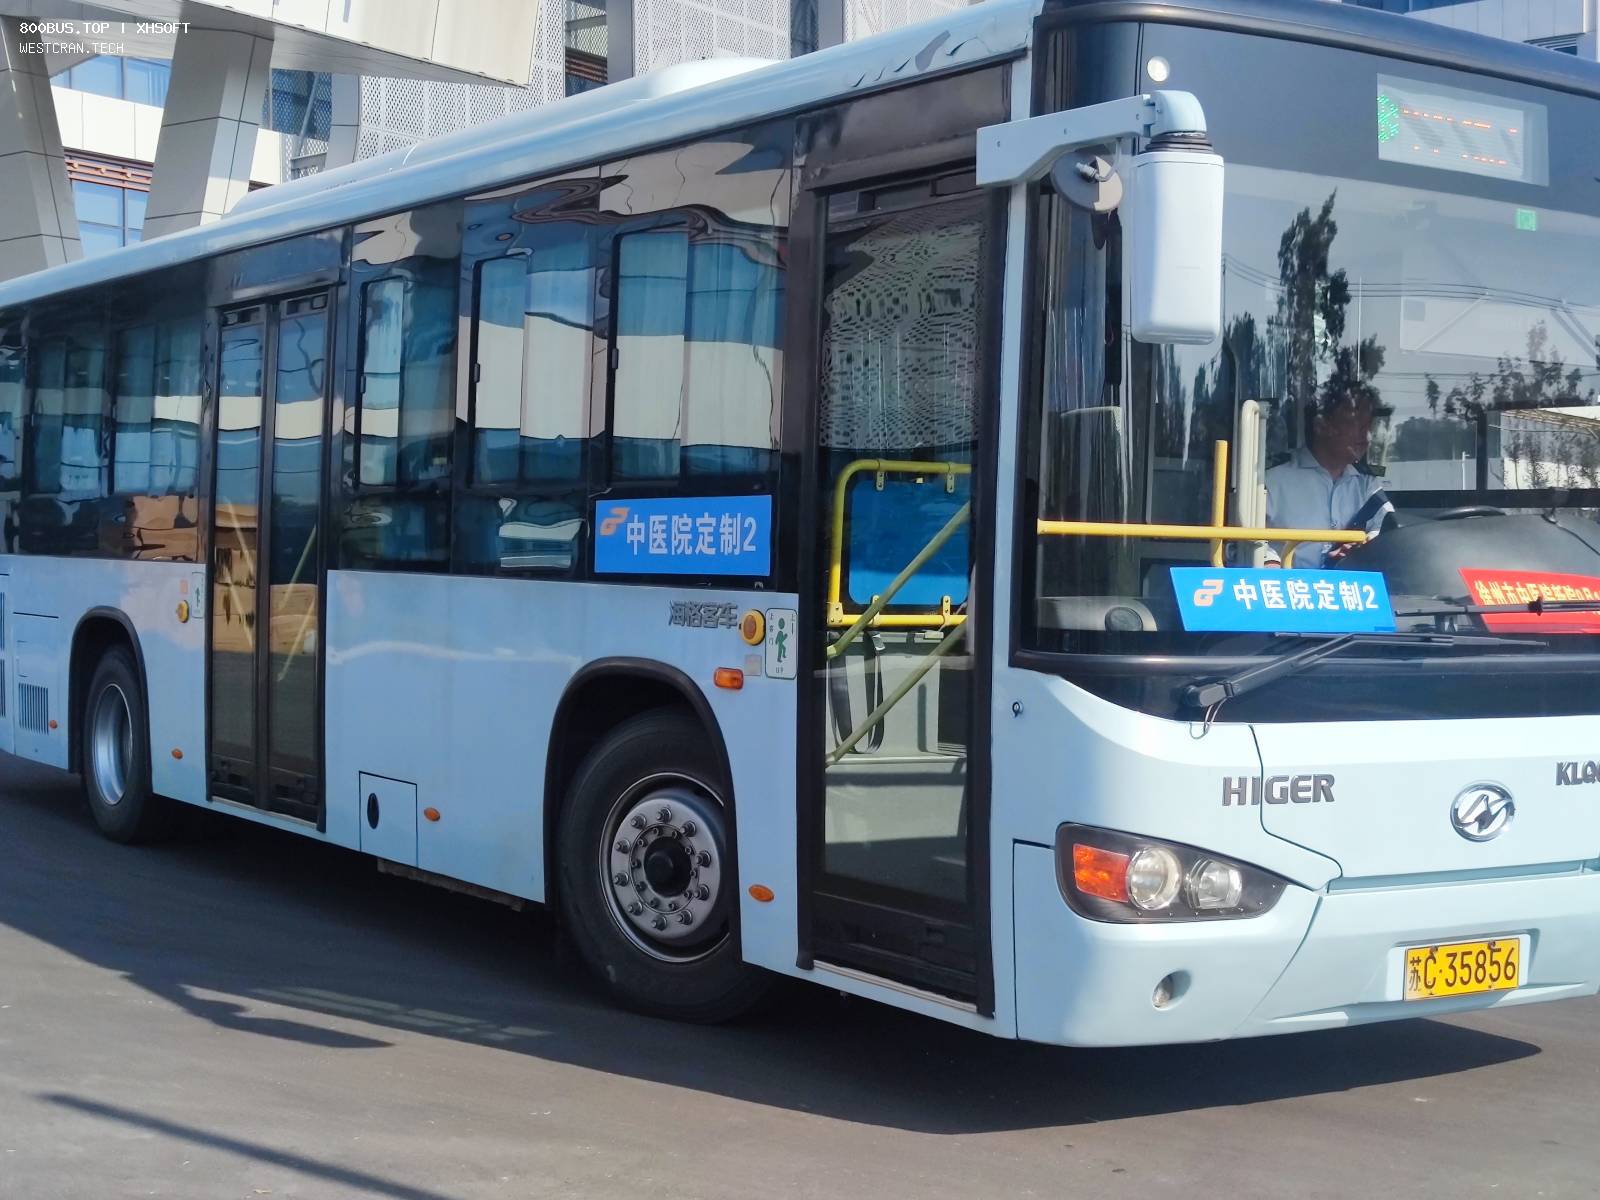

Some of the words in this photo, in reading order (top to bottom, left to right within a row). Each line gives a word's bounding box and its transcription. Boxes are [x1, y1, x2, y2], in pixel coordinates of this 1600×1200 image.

[626, 512, 757, 556] 中医院定制2
[1232, 578, 1379, 612] 中医院定制2
[668, 600, 738, 629] 海格客车
[1221, 773, 1336, 807] HIGER
